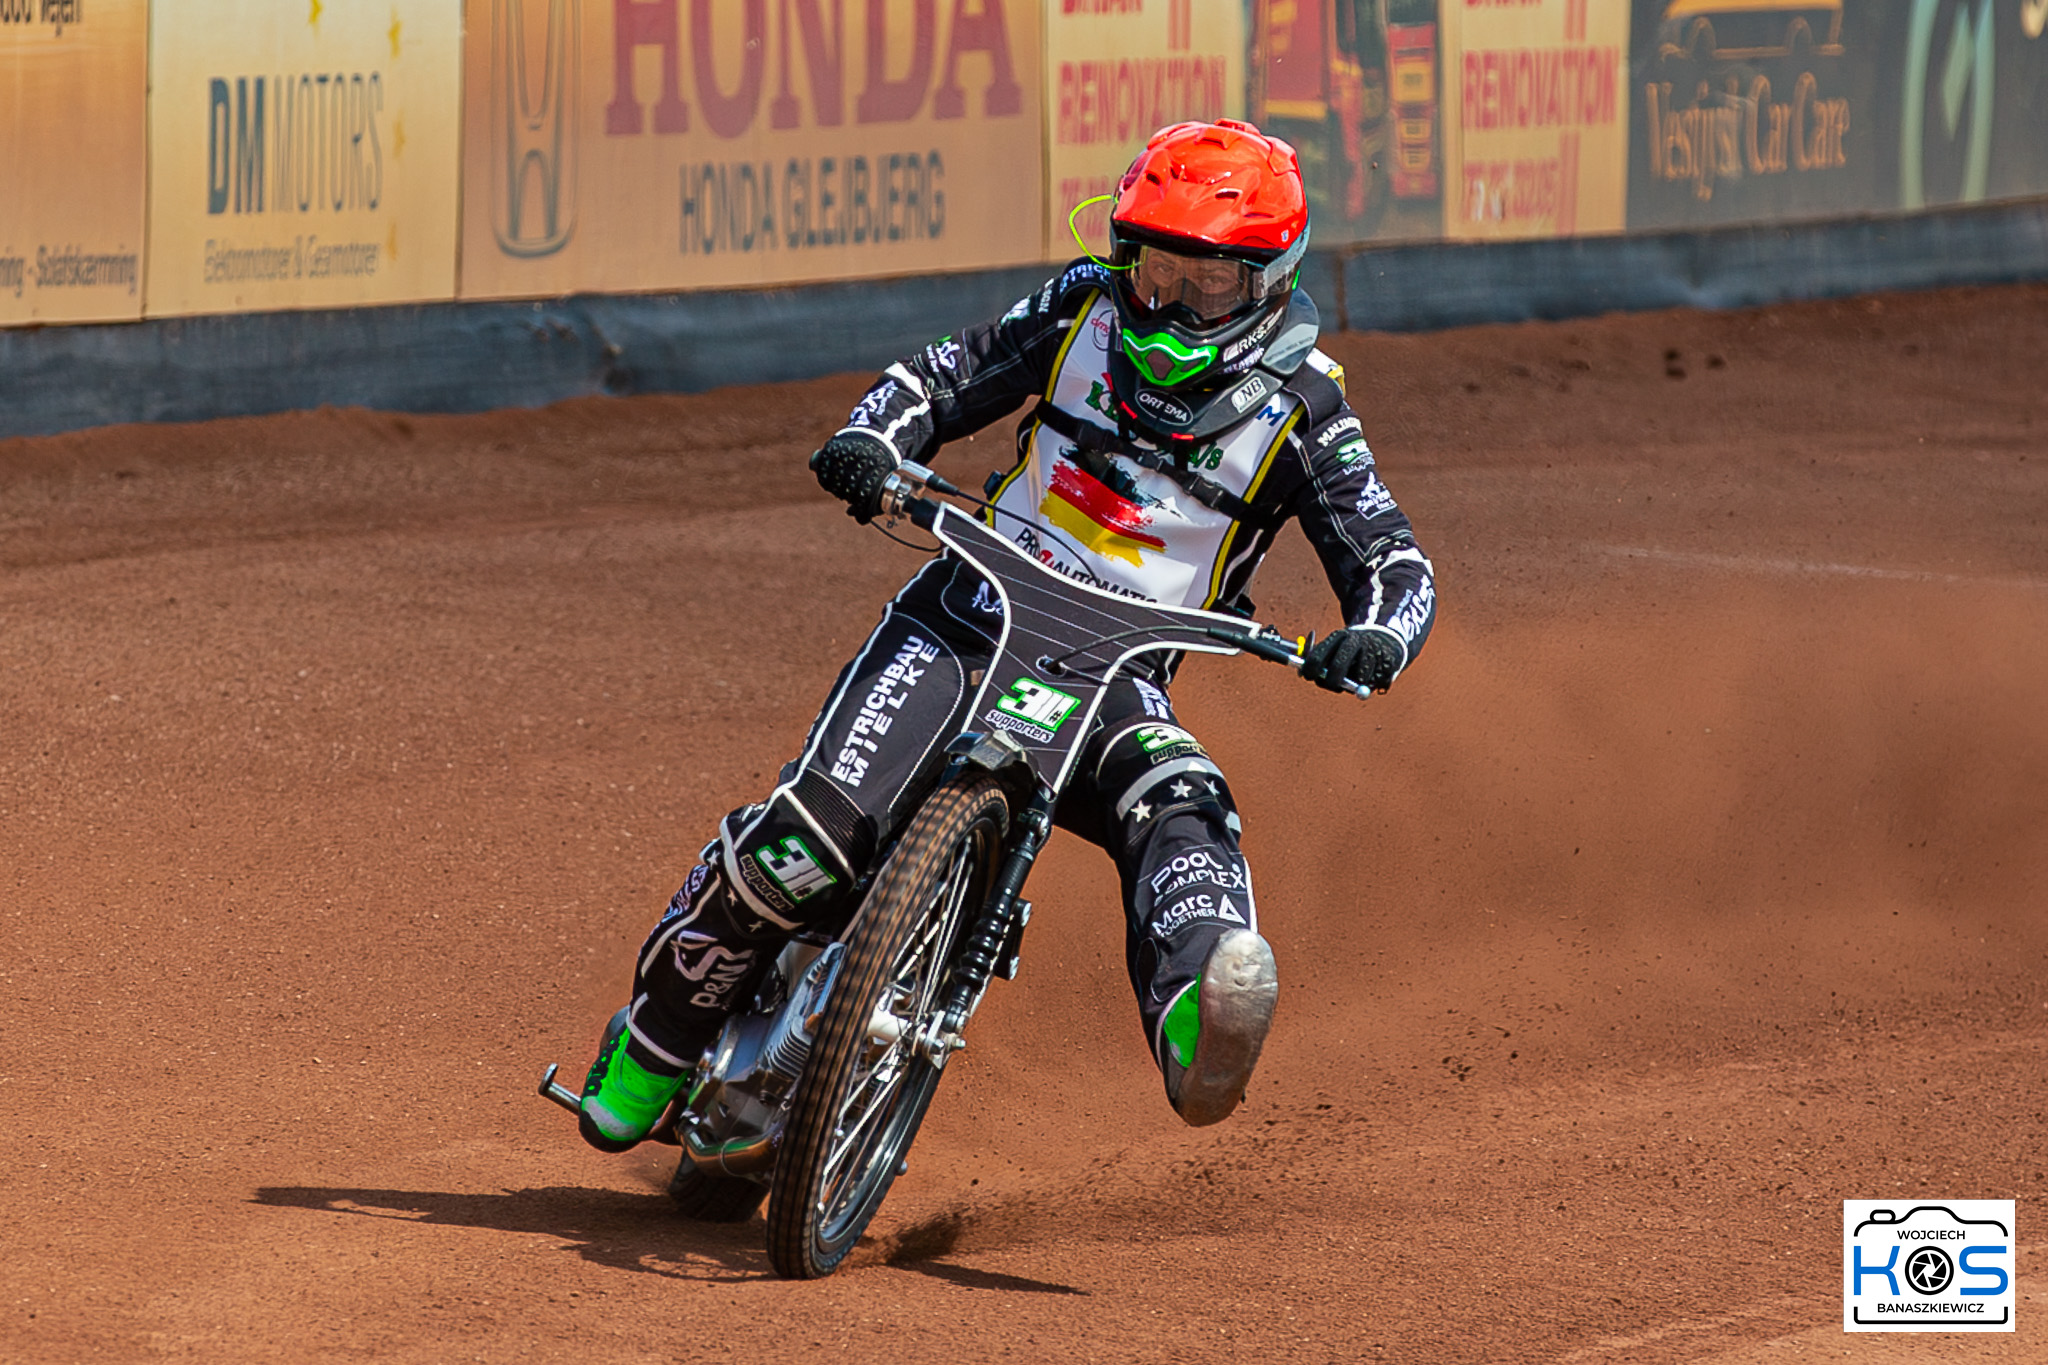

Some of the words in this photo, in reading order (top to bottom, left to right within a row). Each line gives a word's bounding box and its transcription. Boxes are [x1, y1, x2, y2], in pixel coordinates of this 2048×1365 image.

[605, 0, 1023, 138] HONDA
[1057, 55, 1226, 145] RENOVATION
[1462, 45, 1620, 131] RENOVATION
[1746, 74, 1791, 175] Car
[1793, 71, 1850, 172] Care
[679, 160, 779, 256] HONDA
[830, 635, 924, 782] ESTRICHBAU
[846, 643, 940, 787] MIELKE
[986, 710, 1054, 742] supporters
[1151, 852, 1223, 894] POOL
[1152, 895, 1213, 935] Marc
[1161, 908, 1218, 938] TOGETHER
